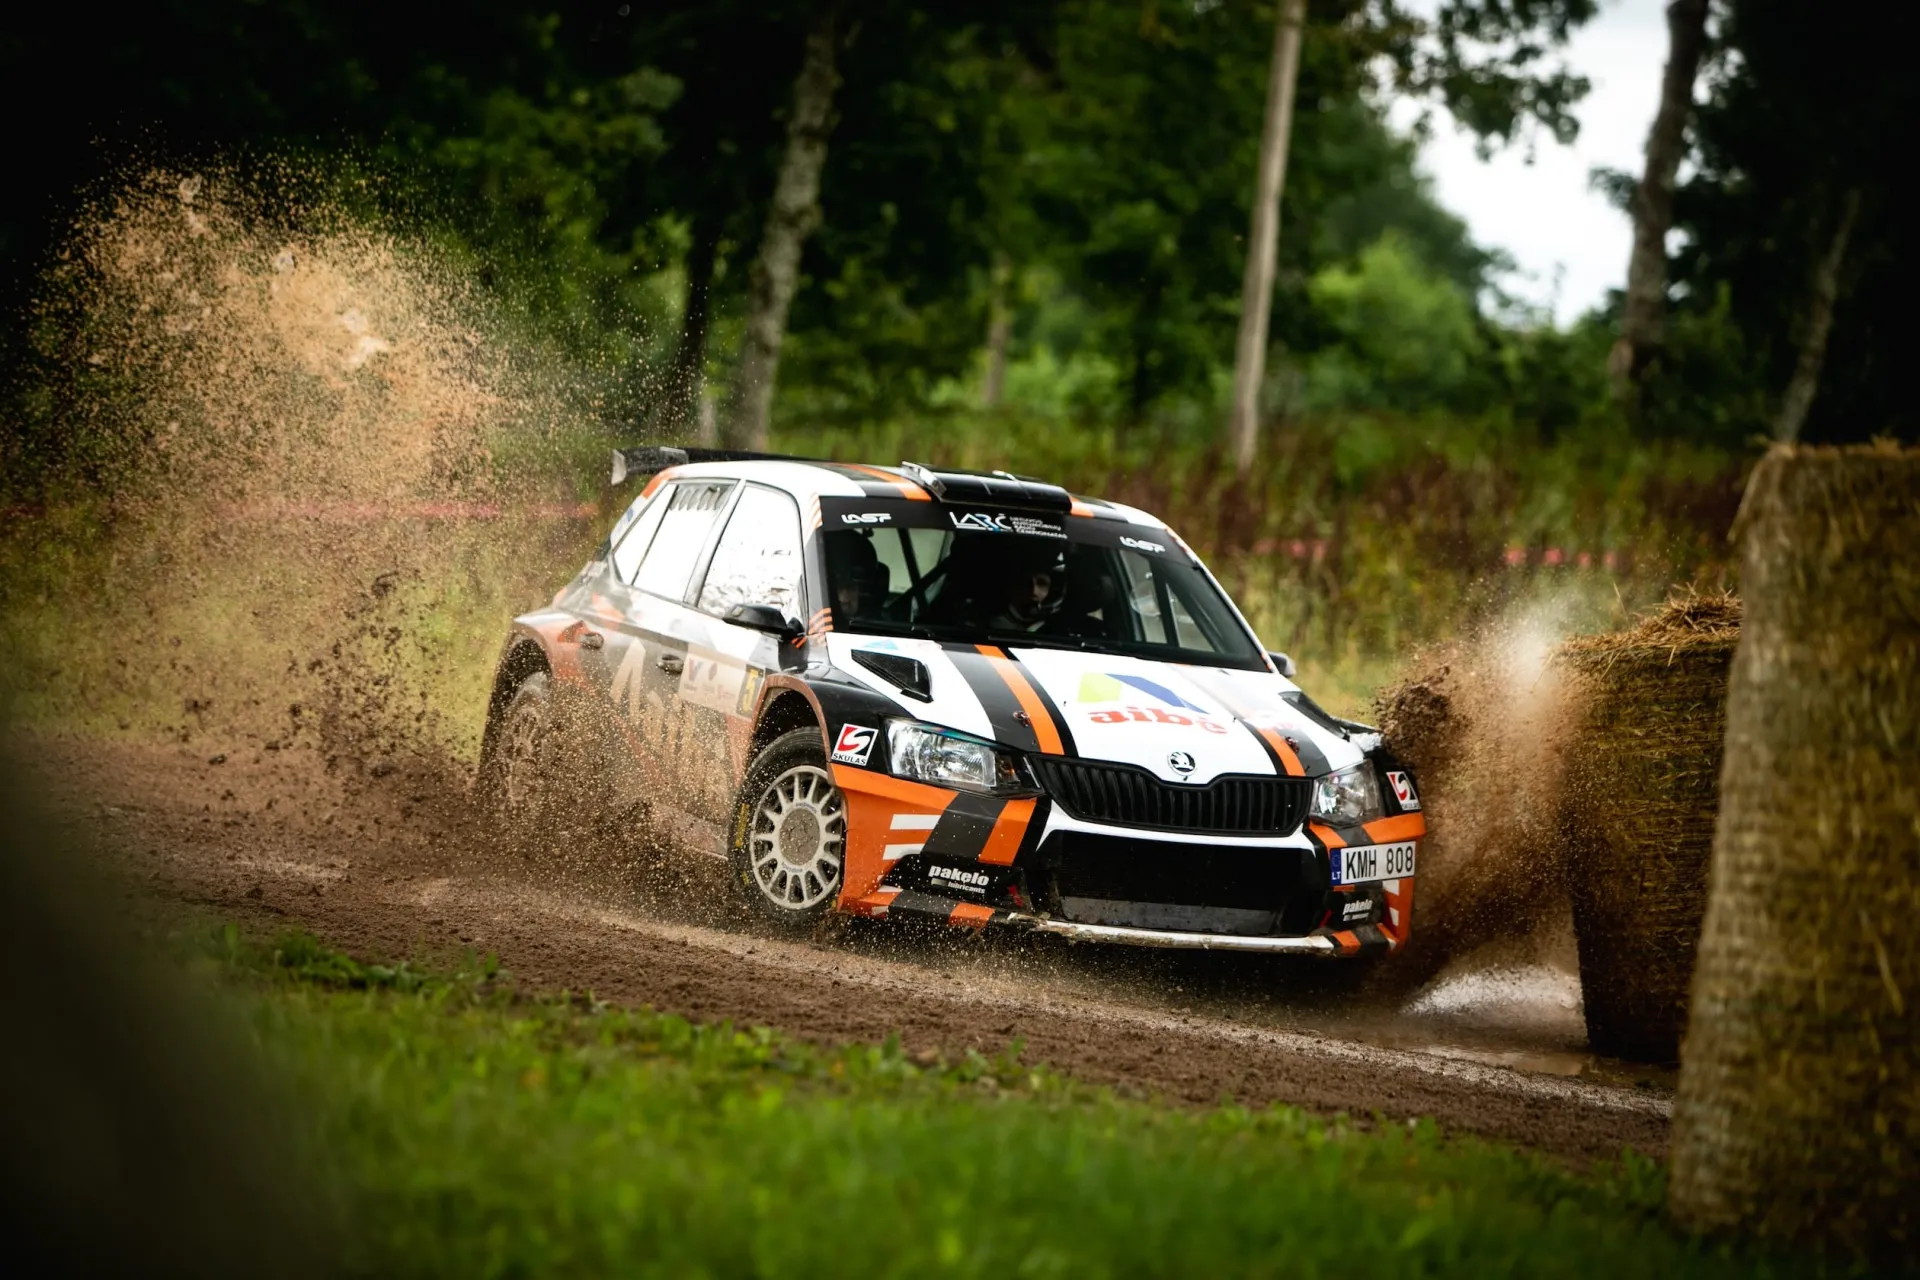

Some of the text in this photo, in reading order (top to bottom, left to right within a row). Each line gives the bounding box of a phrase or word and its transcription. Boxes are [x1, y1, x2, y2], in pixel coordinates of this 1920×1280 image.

[833, 752, 867, 765] SKULAS
[1345, 846, 1414, 880] KMH 808
[928, 865, 990, 887] pakelo
[1331, 871, 1341, 880] LT
[1342, 898, 1373, 916] pakelo
